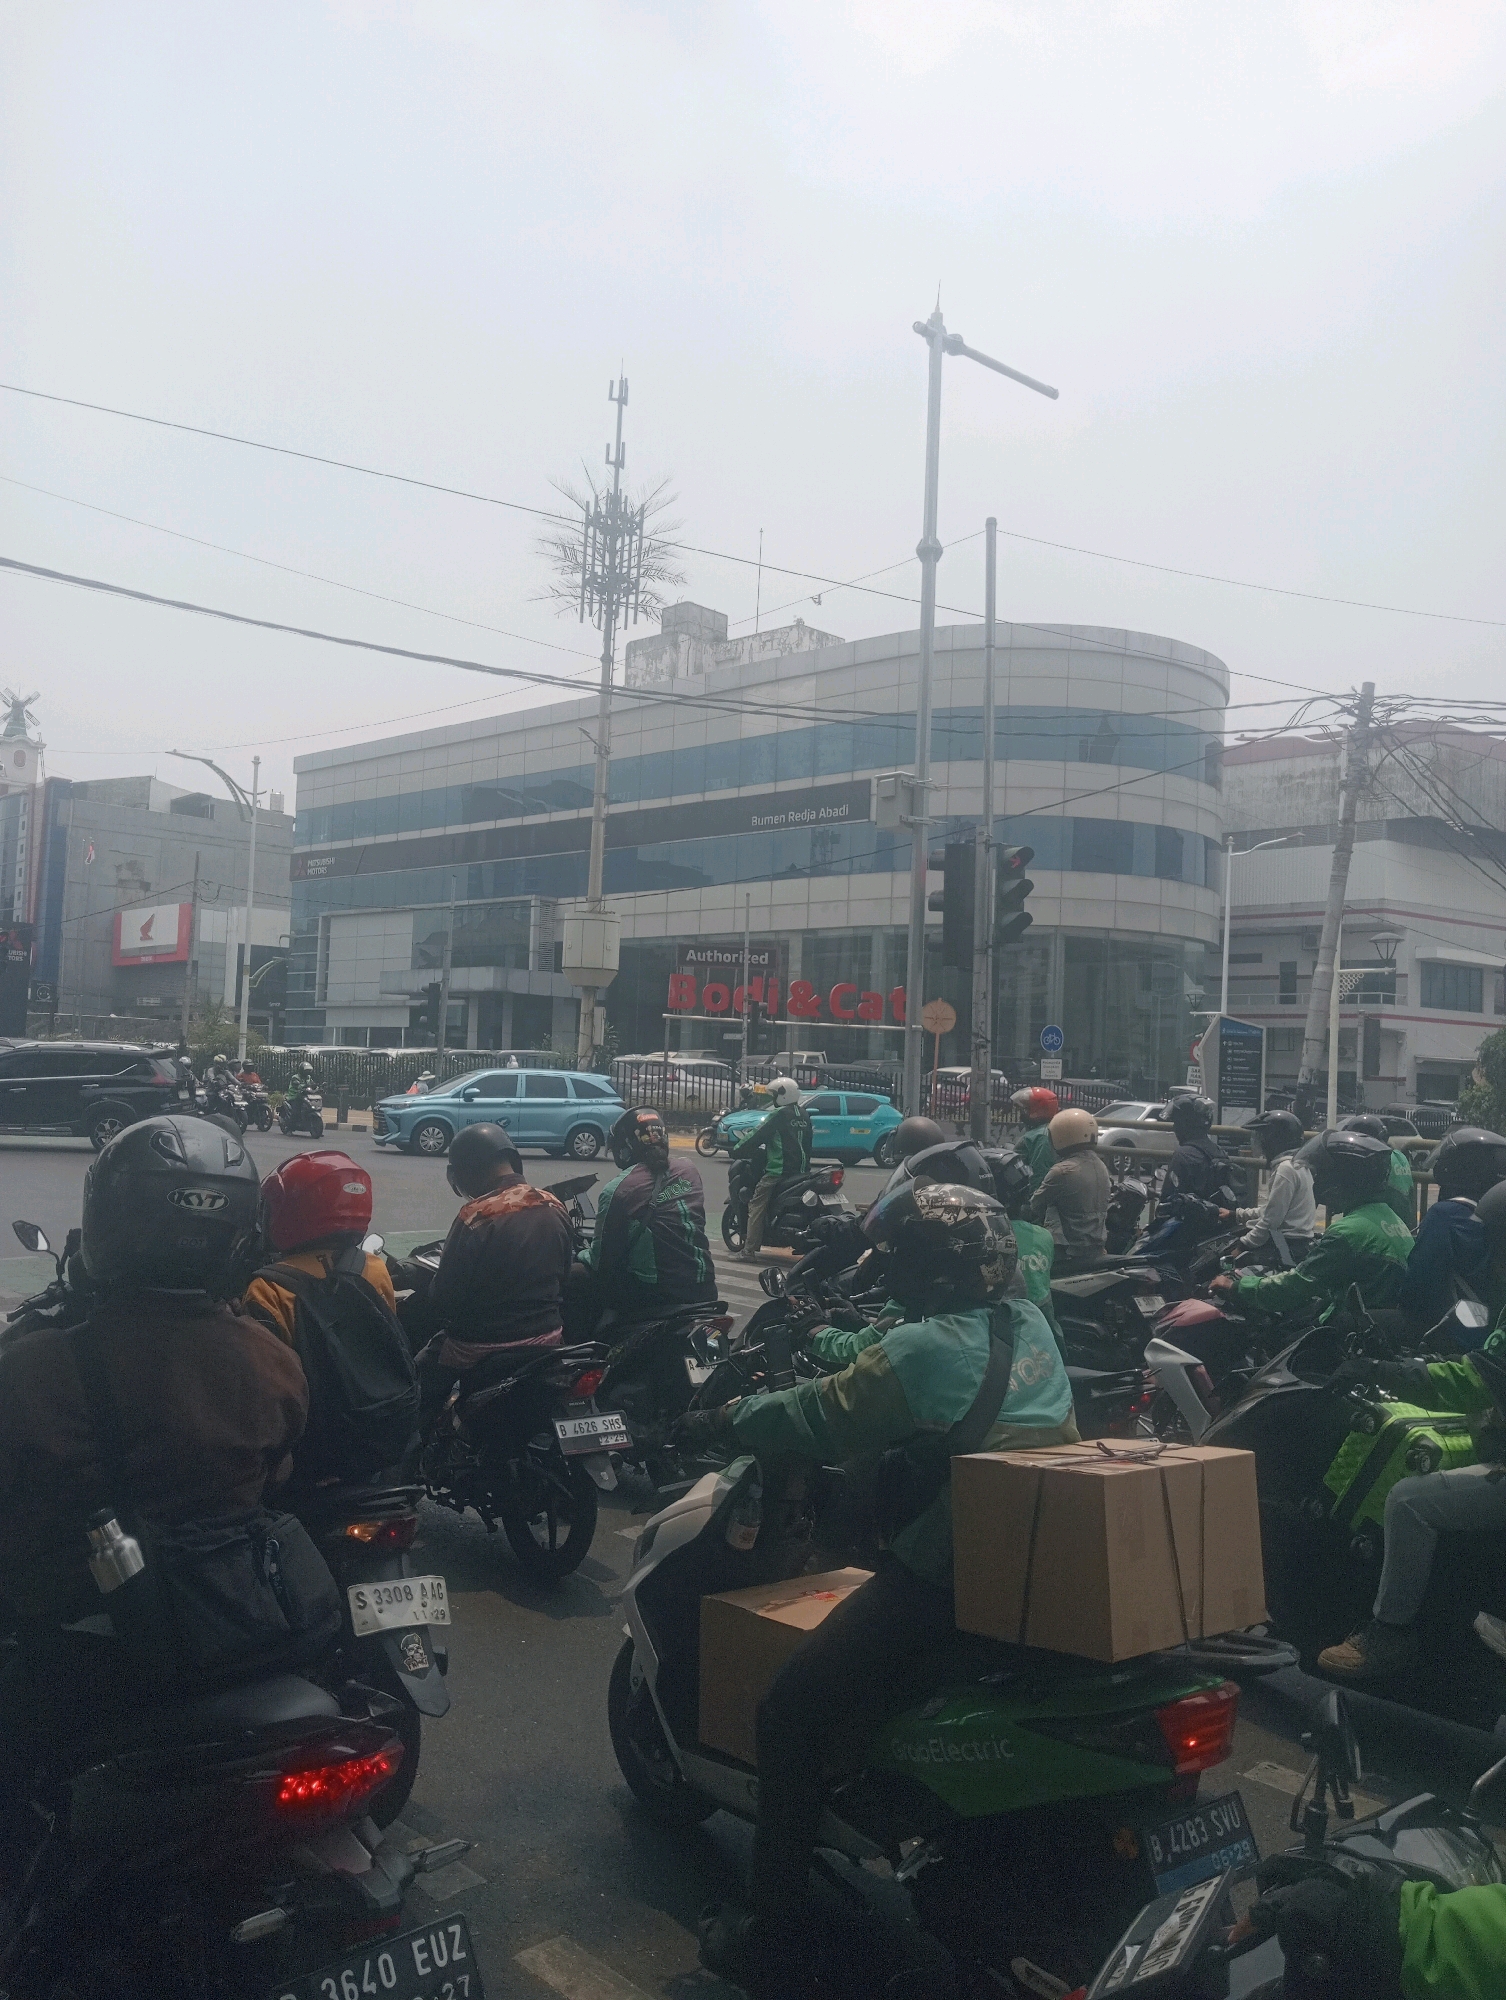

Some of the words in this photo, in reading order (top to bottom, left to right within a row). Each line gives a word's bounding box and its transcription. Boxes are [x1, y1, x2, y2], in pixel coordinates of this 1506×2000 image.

[751, 814, 786, 826] Bumen
[788, 808, 816, 822] Redja
[818, 804, 849, 818] Abadi
[685, 949, 769, 965] Authorized
[176, 1191, 225, 1208] KYT
[1018, 1251, 1050, 1271] rab
[559, 1424, 567, 1437] B
[574, 1421, 598, 1435] 4626
[602, 1417, 622, 1431] SHS
[355, 1590, 368, 1610] S
[373, 1585, 414, 1605] 3308
[1150, 1834, 1163, 1862] B
[1170, 1816, 1209, 1853] 4283
[321, 1953, 397, 2000] 3640
[411, 1924, 467, 1976] EUZ
